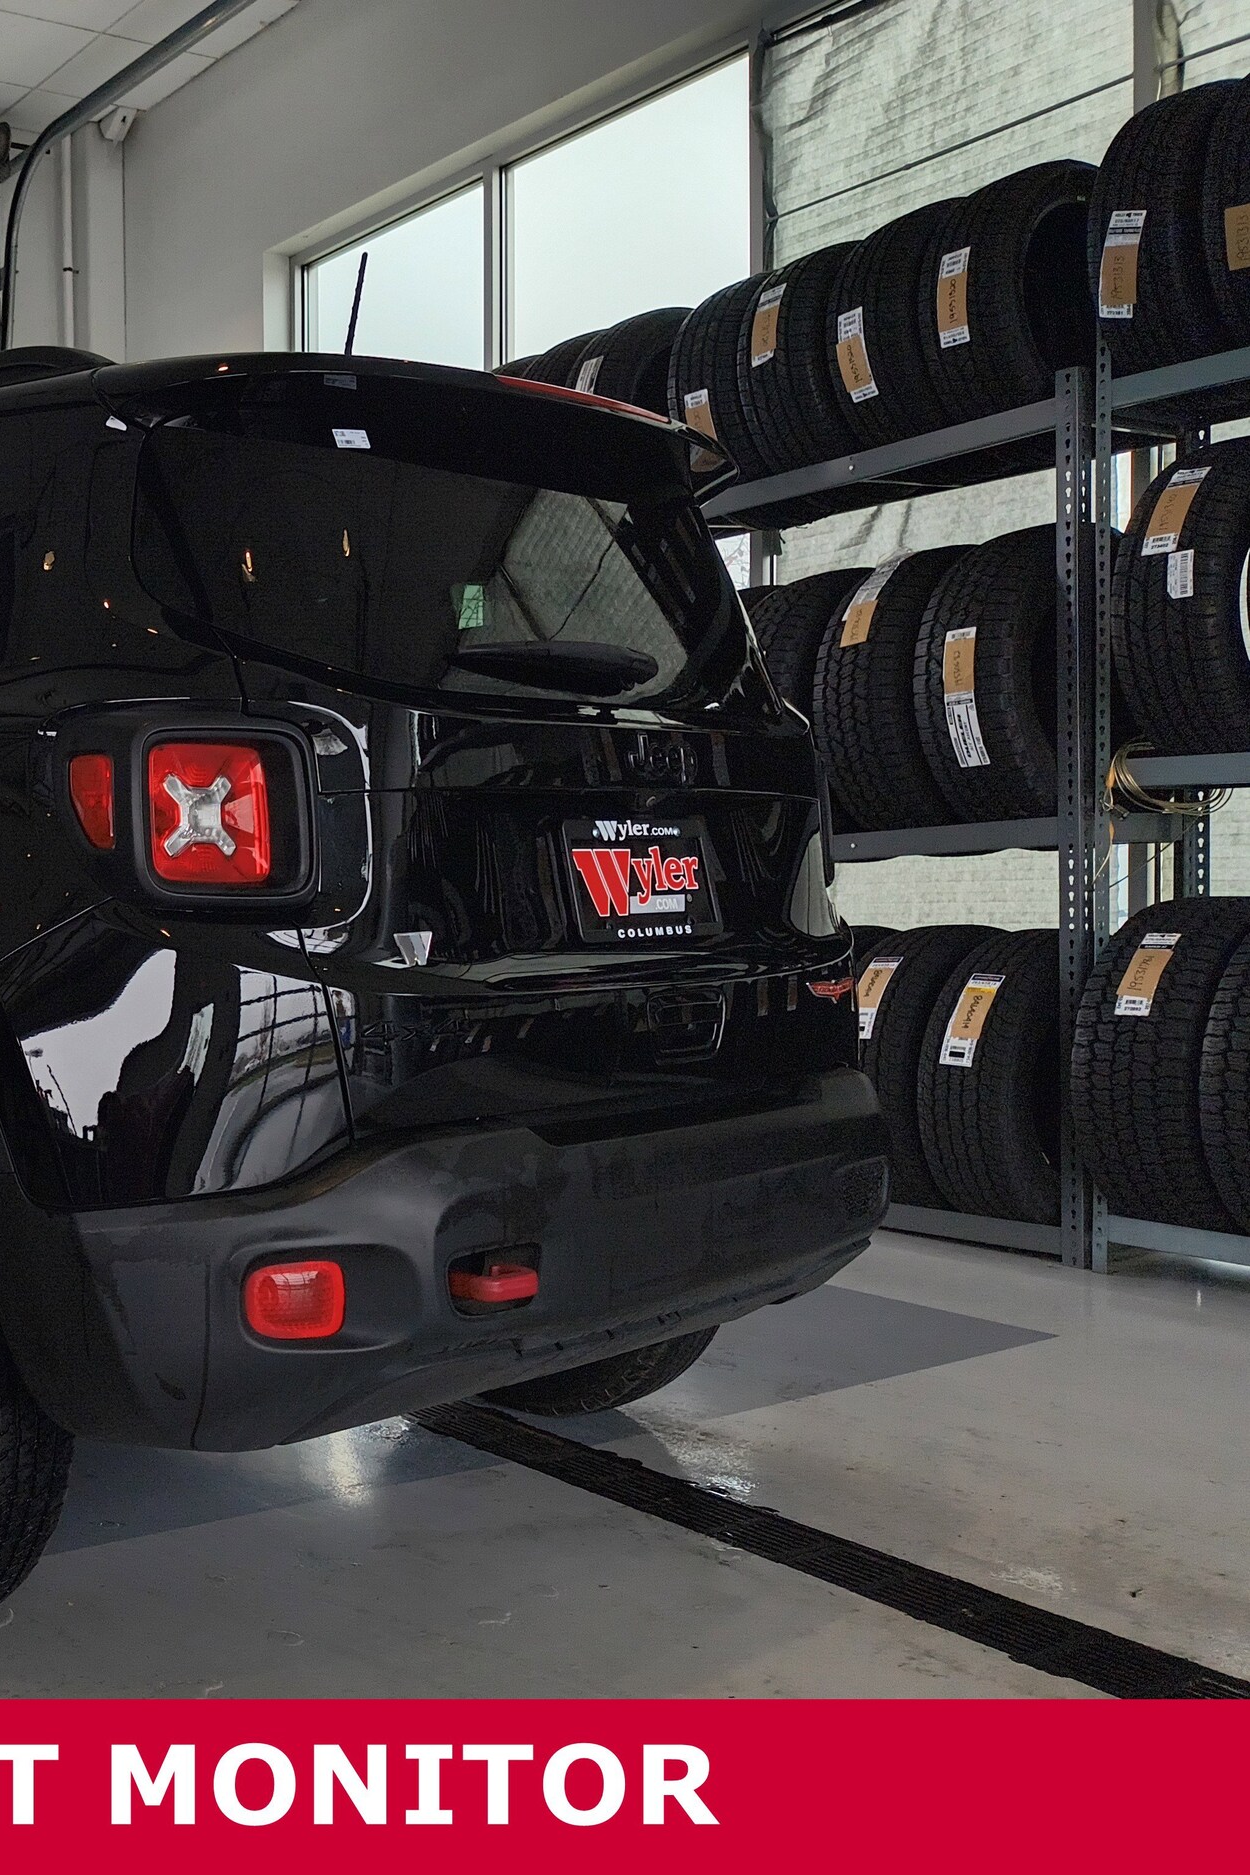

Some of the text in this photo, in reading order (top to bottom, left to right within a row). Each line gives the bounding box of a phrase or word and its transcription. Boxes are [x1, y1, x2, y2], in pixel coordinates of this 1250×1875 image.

[626, 731, 698, 784] Jeep
[571, 846, 699, 918] Wyler
[617, 924, 693, 939] COLUMBUS
